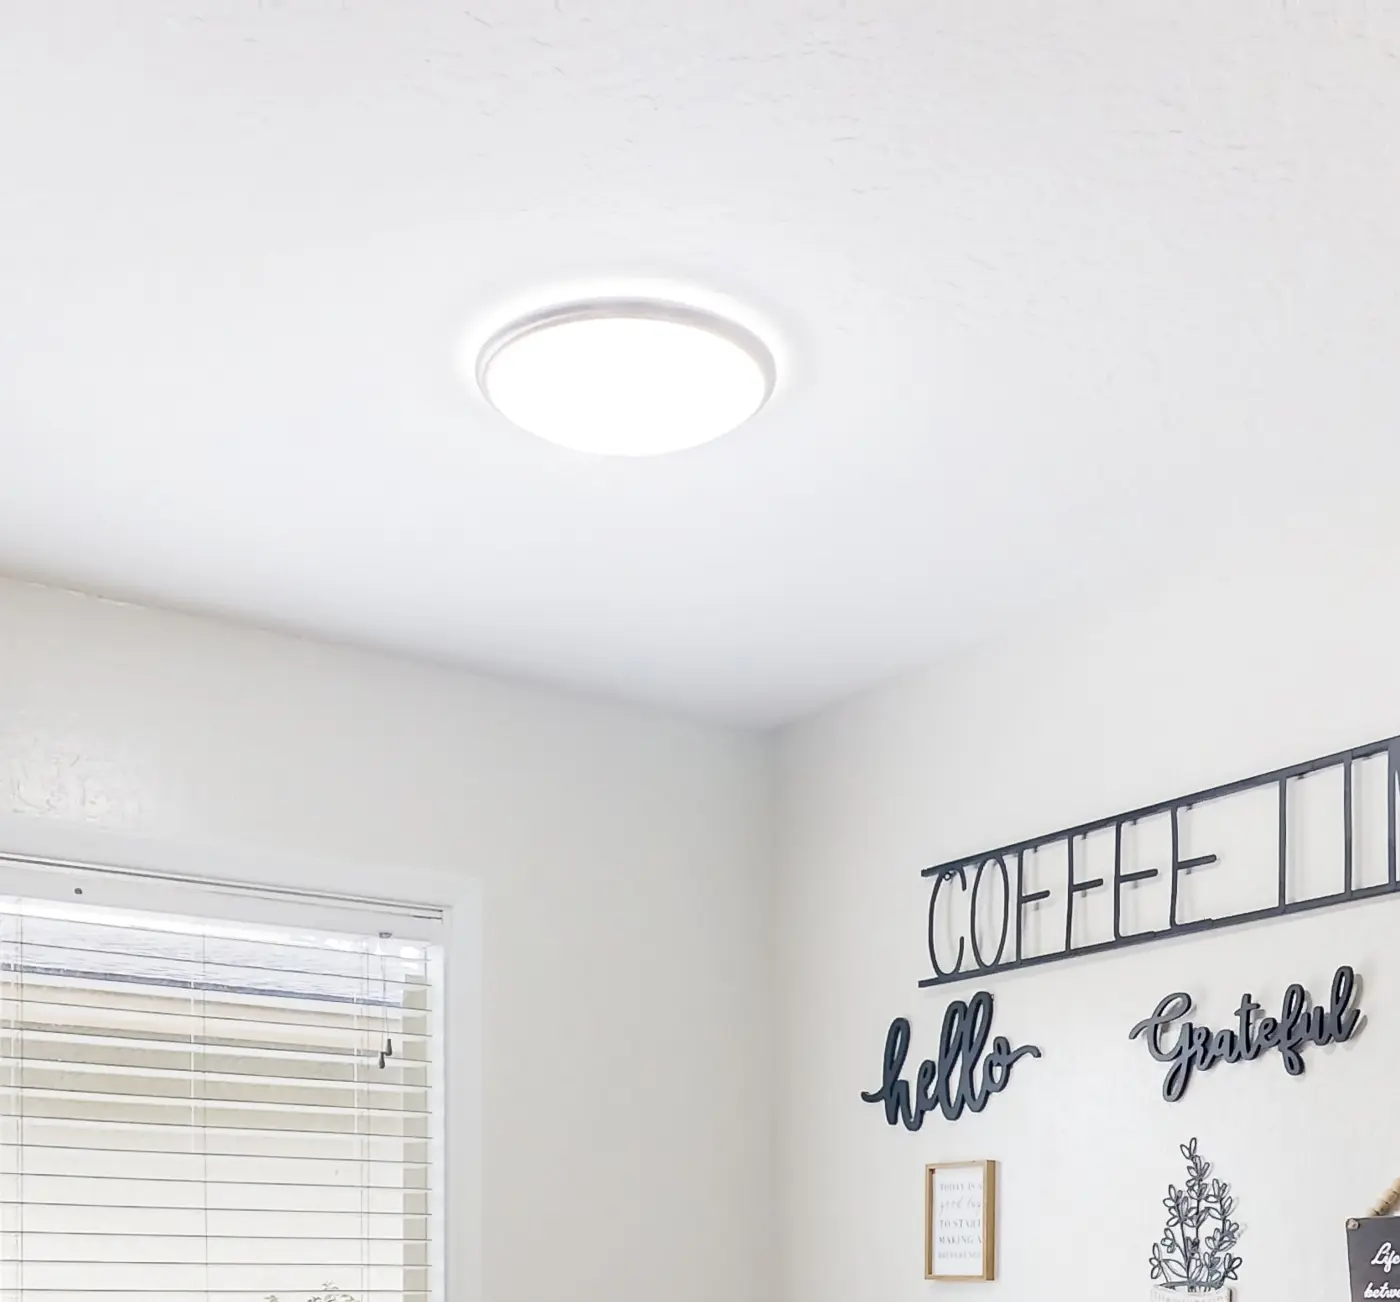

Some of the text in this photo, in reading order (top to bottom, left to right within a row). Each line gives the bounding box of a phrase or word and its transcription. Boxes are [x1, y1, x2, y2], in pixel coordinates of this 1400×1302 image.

[928, 803, 1217, 977] COFFEE
[861, 990, 1041, 1130] hello
[1129, 965, 1362, 1103] Grateful
[1371, 1242, 1400, 1273] Life
